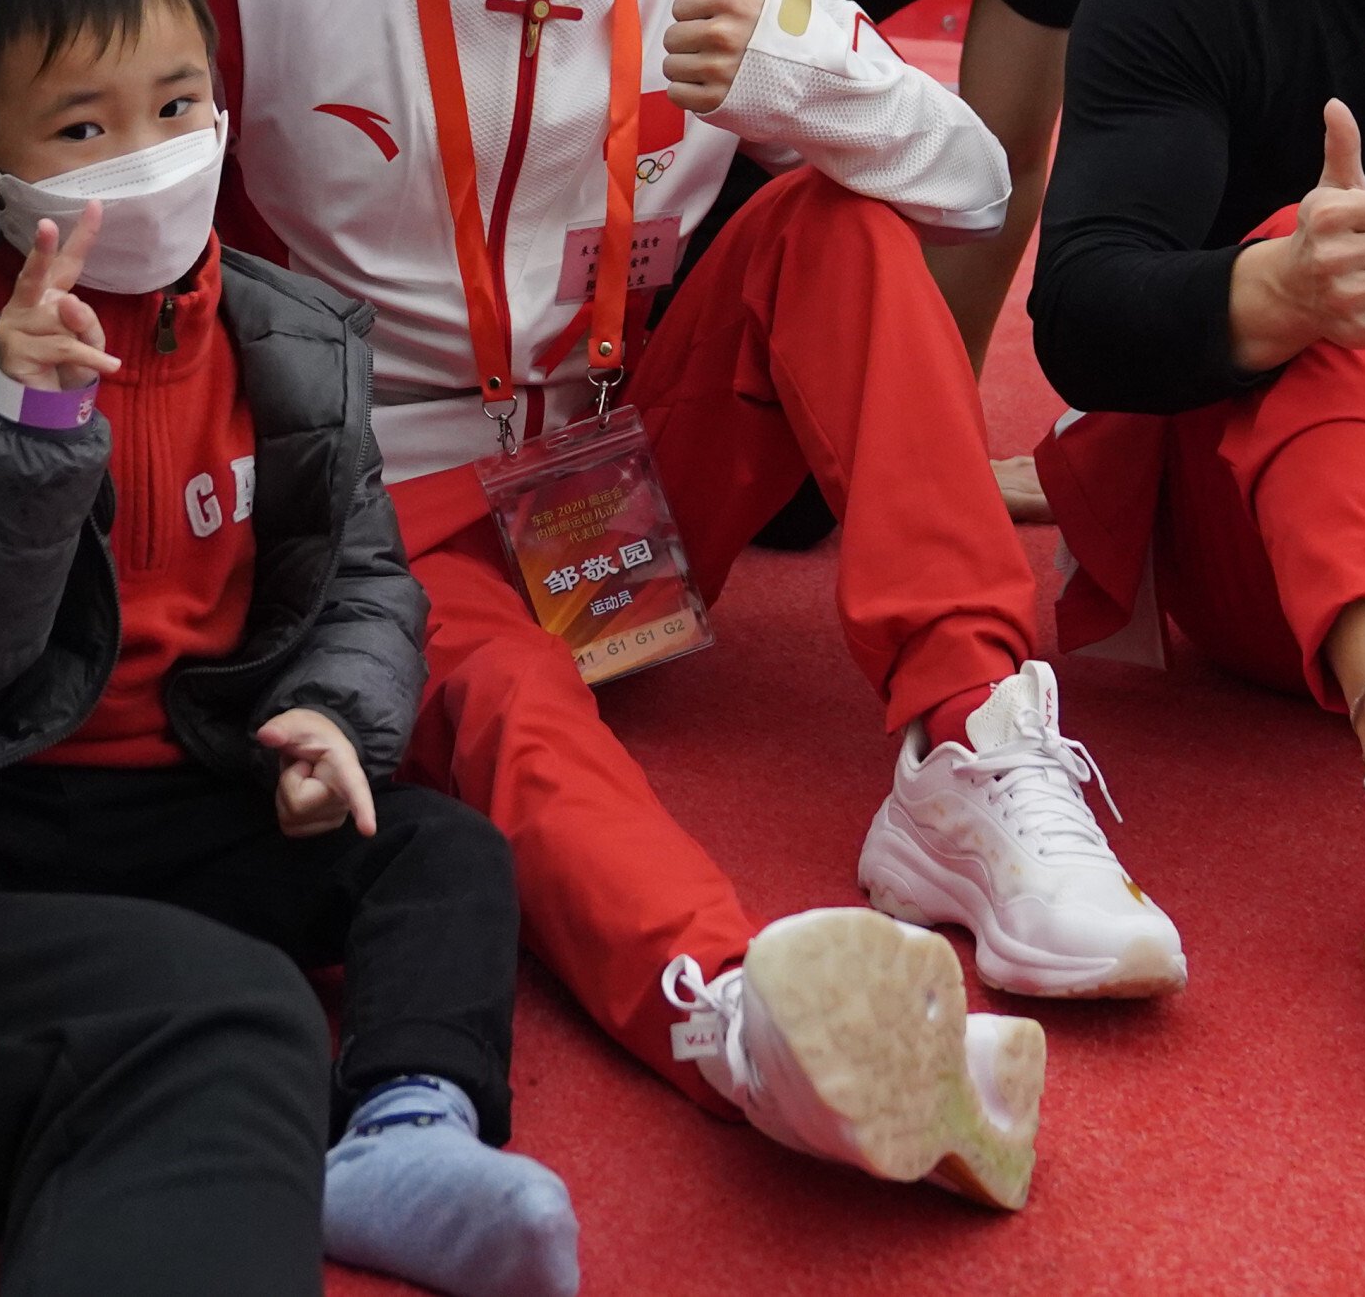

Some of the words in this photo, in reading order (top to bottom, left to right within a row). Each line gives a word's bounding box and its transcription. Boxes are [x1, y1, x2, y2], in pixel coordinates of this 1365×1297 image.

[557, 499, 586, 517] 2020
[543, 539, 654, 596] 邹敬园
[590, 590, 634, 618] 运动员
[663, 619, 686, 634] G2
